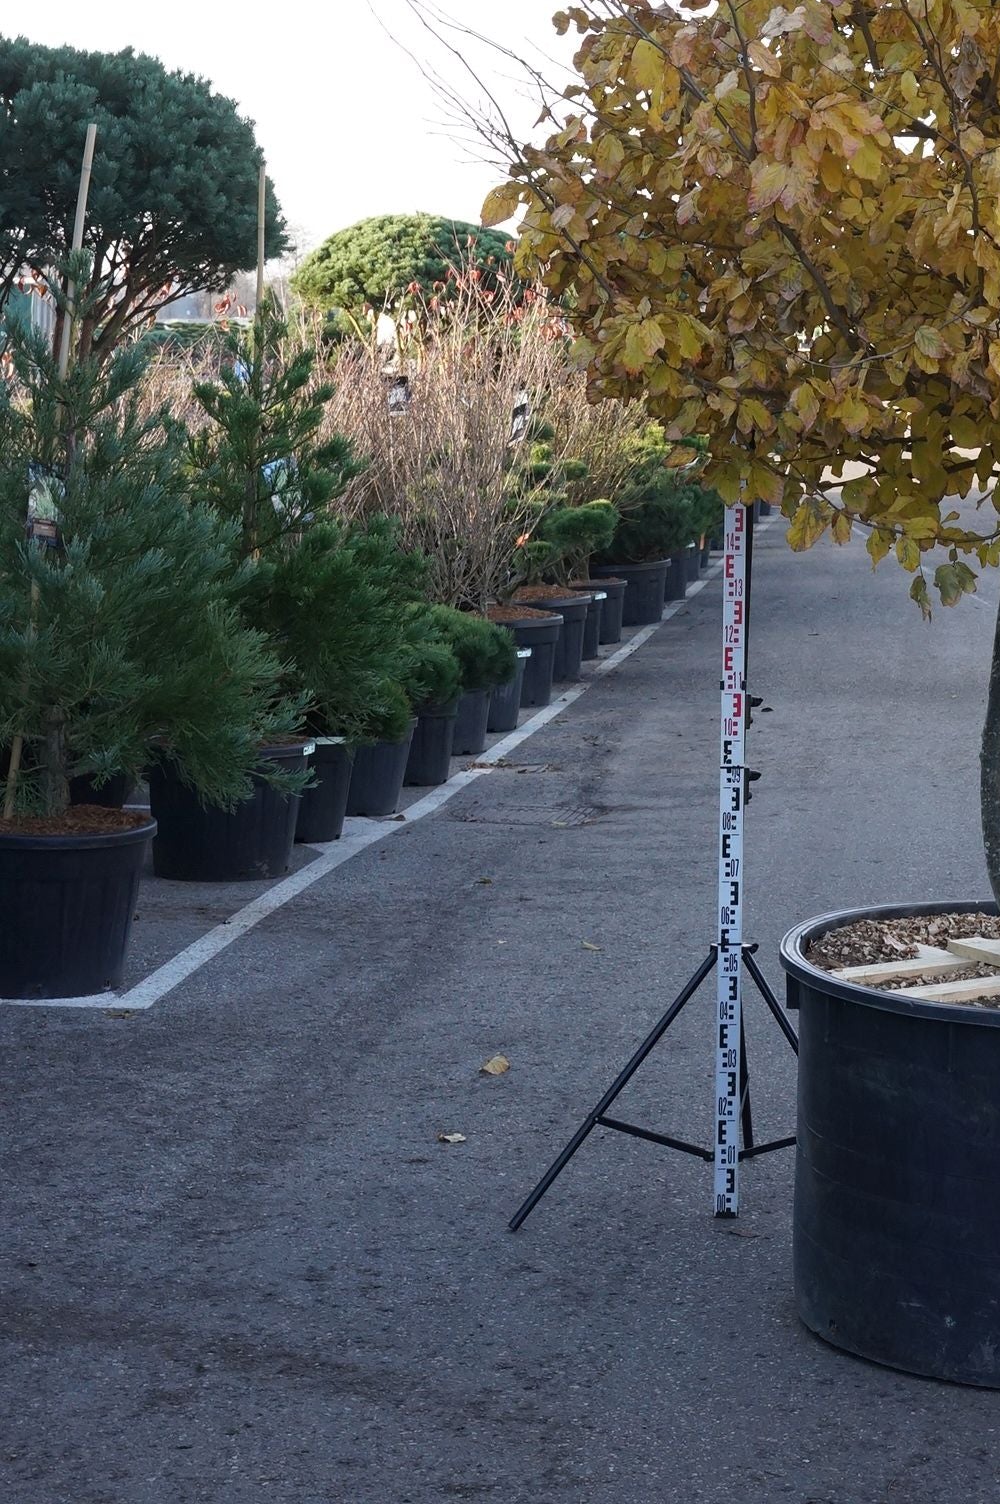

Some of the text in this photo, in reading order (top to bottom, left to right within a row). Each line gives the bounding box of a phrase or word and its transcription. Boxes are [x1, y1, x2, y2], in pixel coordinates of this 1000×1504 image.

[726, 533, 734, 550] 14
[734, 578, 743, 597] 13
[725, 625, 733, 643] 12
[733, 671, 742, 689] 11
[724, 718, 732, 736] 10
[732, 765, 740, 783] 09
[722, 812, 731, 830] 08
[730, 859, 739, 877] 07
[721, 906, 729, 924] 06
[729, 953, 738, 972] 05
[720, 1001, 728, 1020] 04
[728, 1049, 737, 1068] 03
[718, 1097, 727, 1115] 02
[728, 1145, 735, 1164] 01
[717, 1194, 725, 1212] 00
